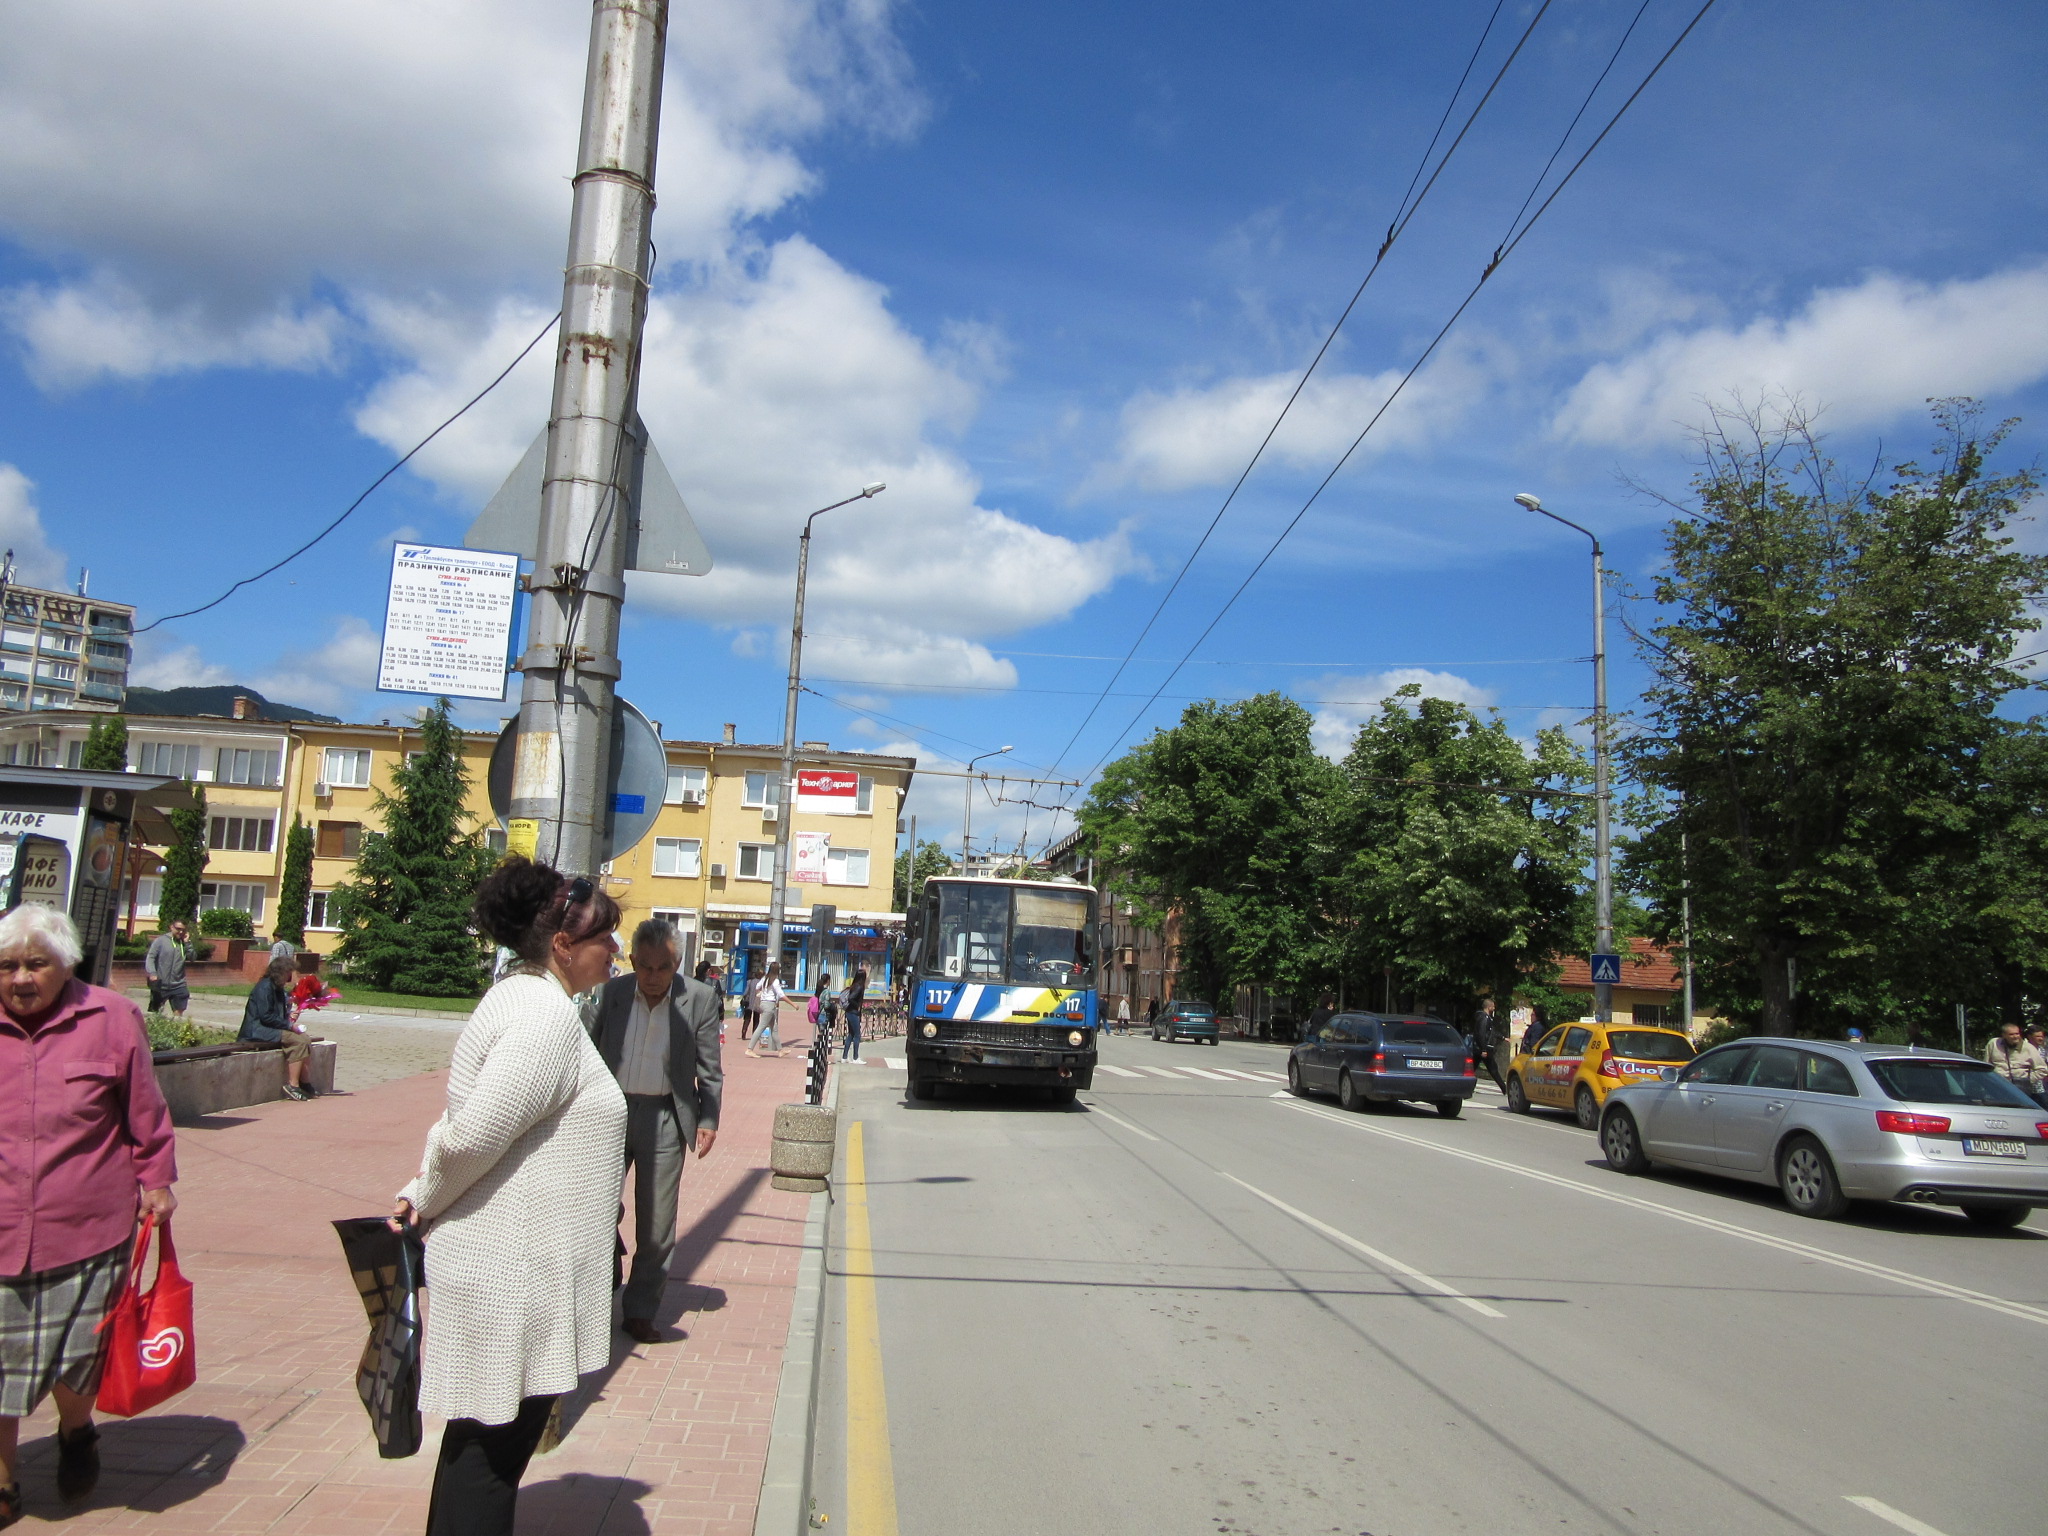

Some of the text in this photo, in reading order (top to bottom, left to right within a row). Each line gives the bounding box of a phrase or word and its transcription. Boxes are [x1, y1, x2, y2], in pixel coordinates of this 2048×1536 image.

[397, 561, 511, 578] ПРАЗНИЧНО РАЗПИСАНИЕ
[1, 812, 45, 827] КАФЕ
[26, 857, 58, 872] АФЕ
[23, 873, 57, 889] ИНО
[782, 924, 815, 933] ПТЕК
[949, 959, 958, 974] 4
[928, 989, 953, 1005] 117
[1065, 997, 1080, 1012] 117
[1591, 1040, 1601, 1050] 88
